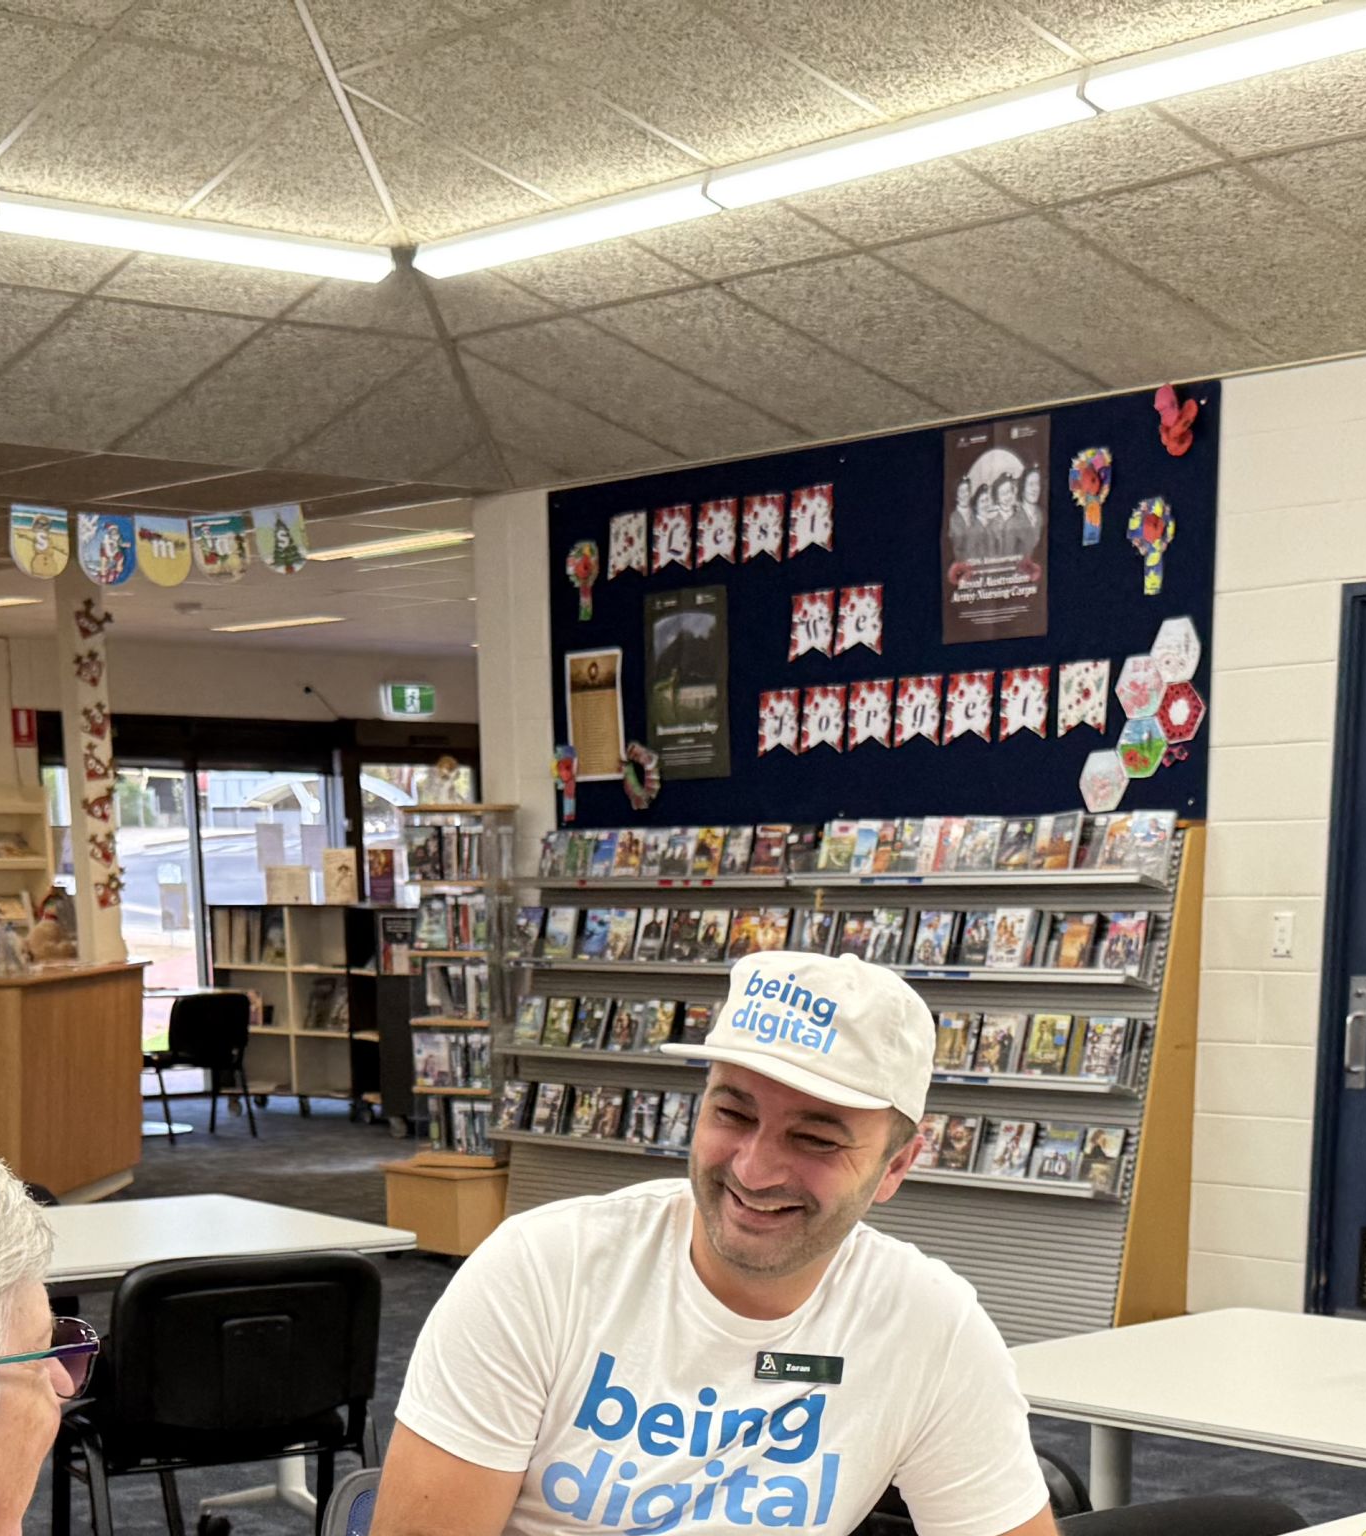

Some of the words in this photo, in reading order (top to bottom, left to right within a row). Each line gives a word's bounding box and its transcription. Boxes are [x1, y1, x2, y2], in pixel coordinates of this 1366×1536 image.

[732, 1001, 838, 1054] digital
[744, 970, 837, 1027] being
[573, 1351, 827, 1465] being
[540, 1448, 841, 1536] digital
